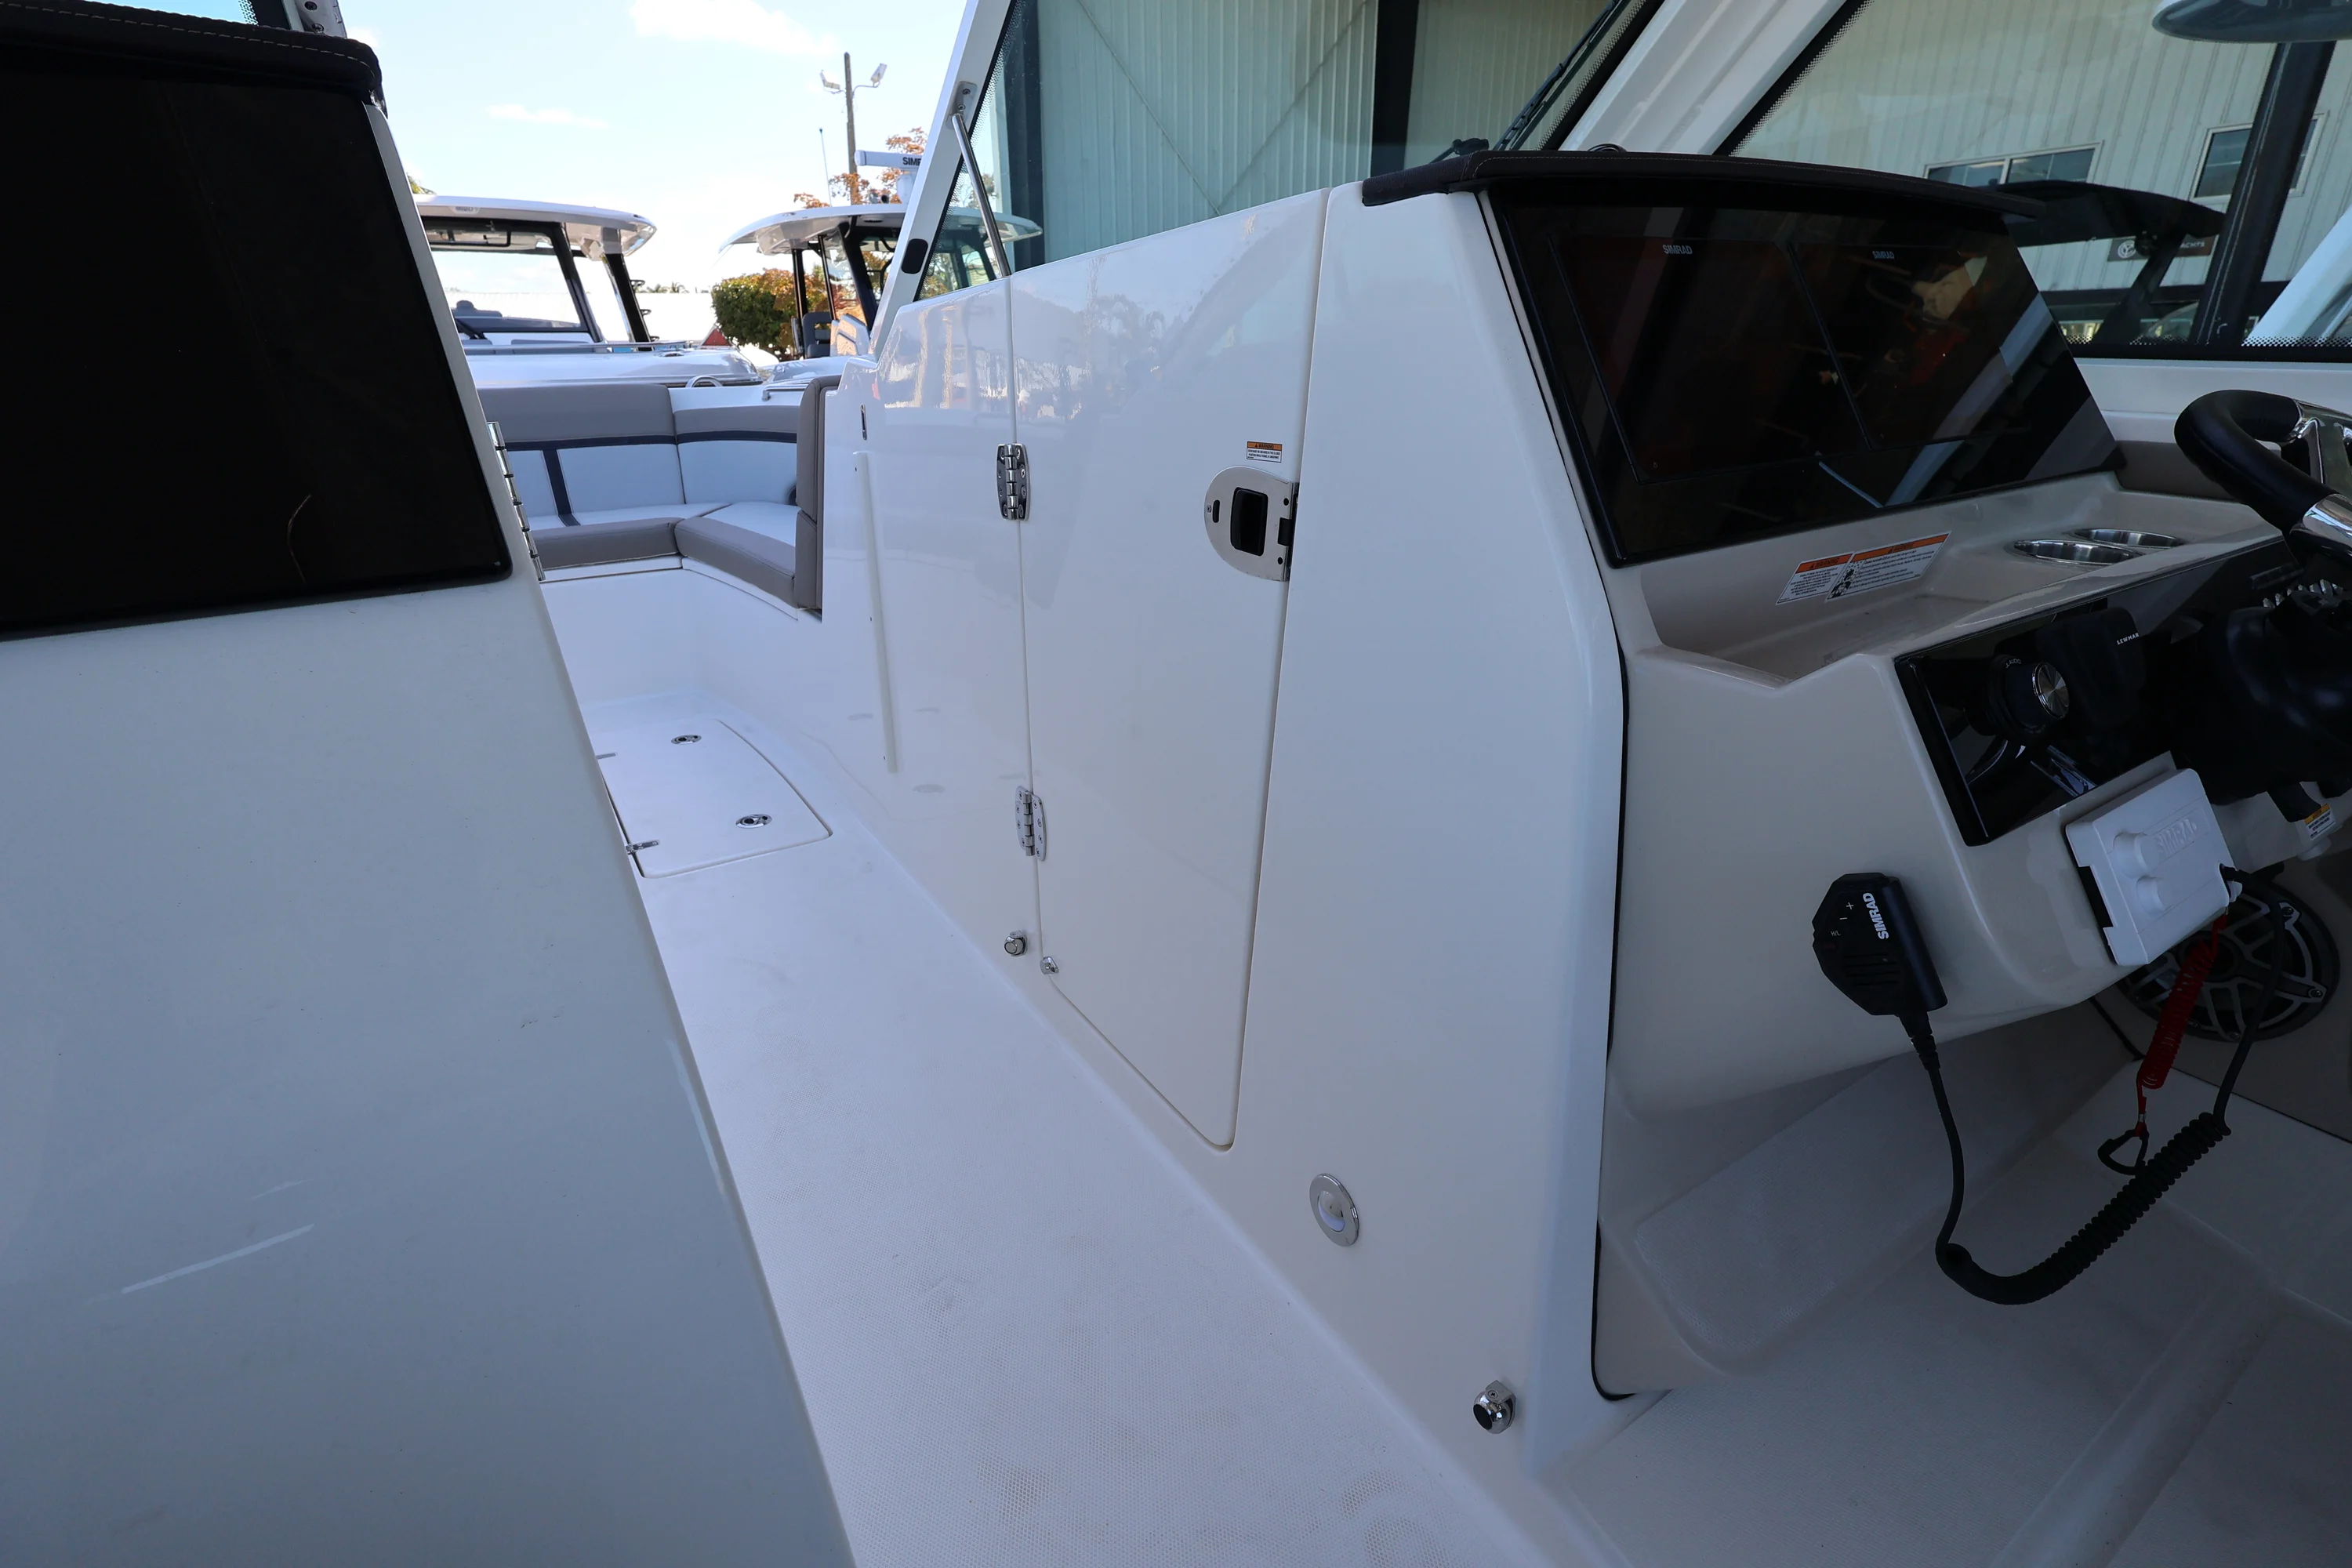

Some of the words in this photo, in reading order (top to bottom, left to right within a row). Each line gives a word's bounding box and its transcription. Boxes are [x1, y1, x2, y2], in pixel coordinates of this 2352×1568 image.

[1662, 244, 1693, 255] SIMRAD
[1872, 250, 1896, 260] SIMRAD
[2116, 633, 2140, 645] LEWMAR
[1863, 892, 1889, 940] SIMRAD
